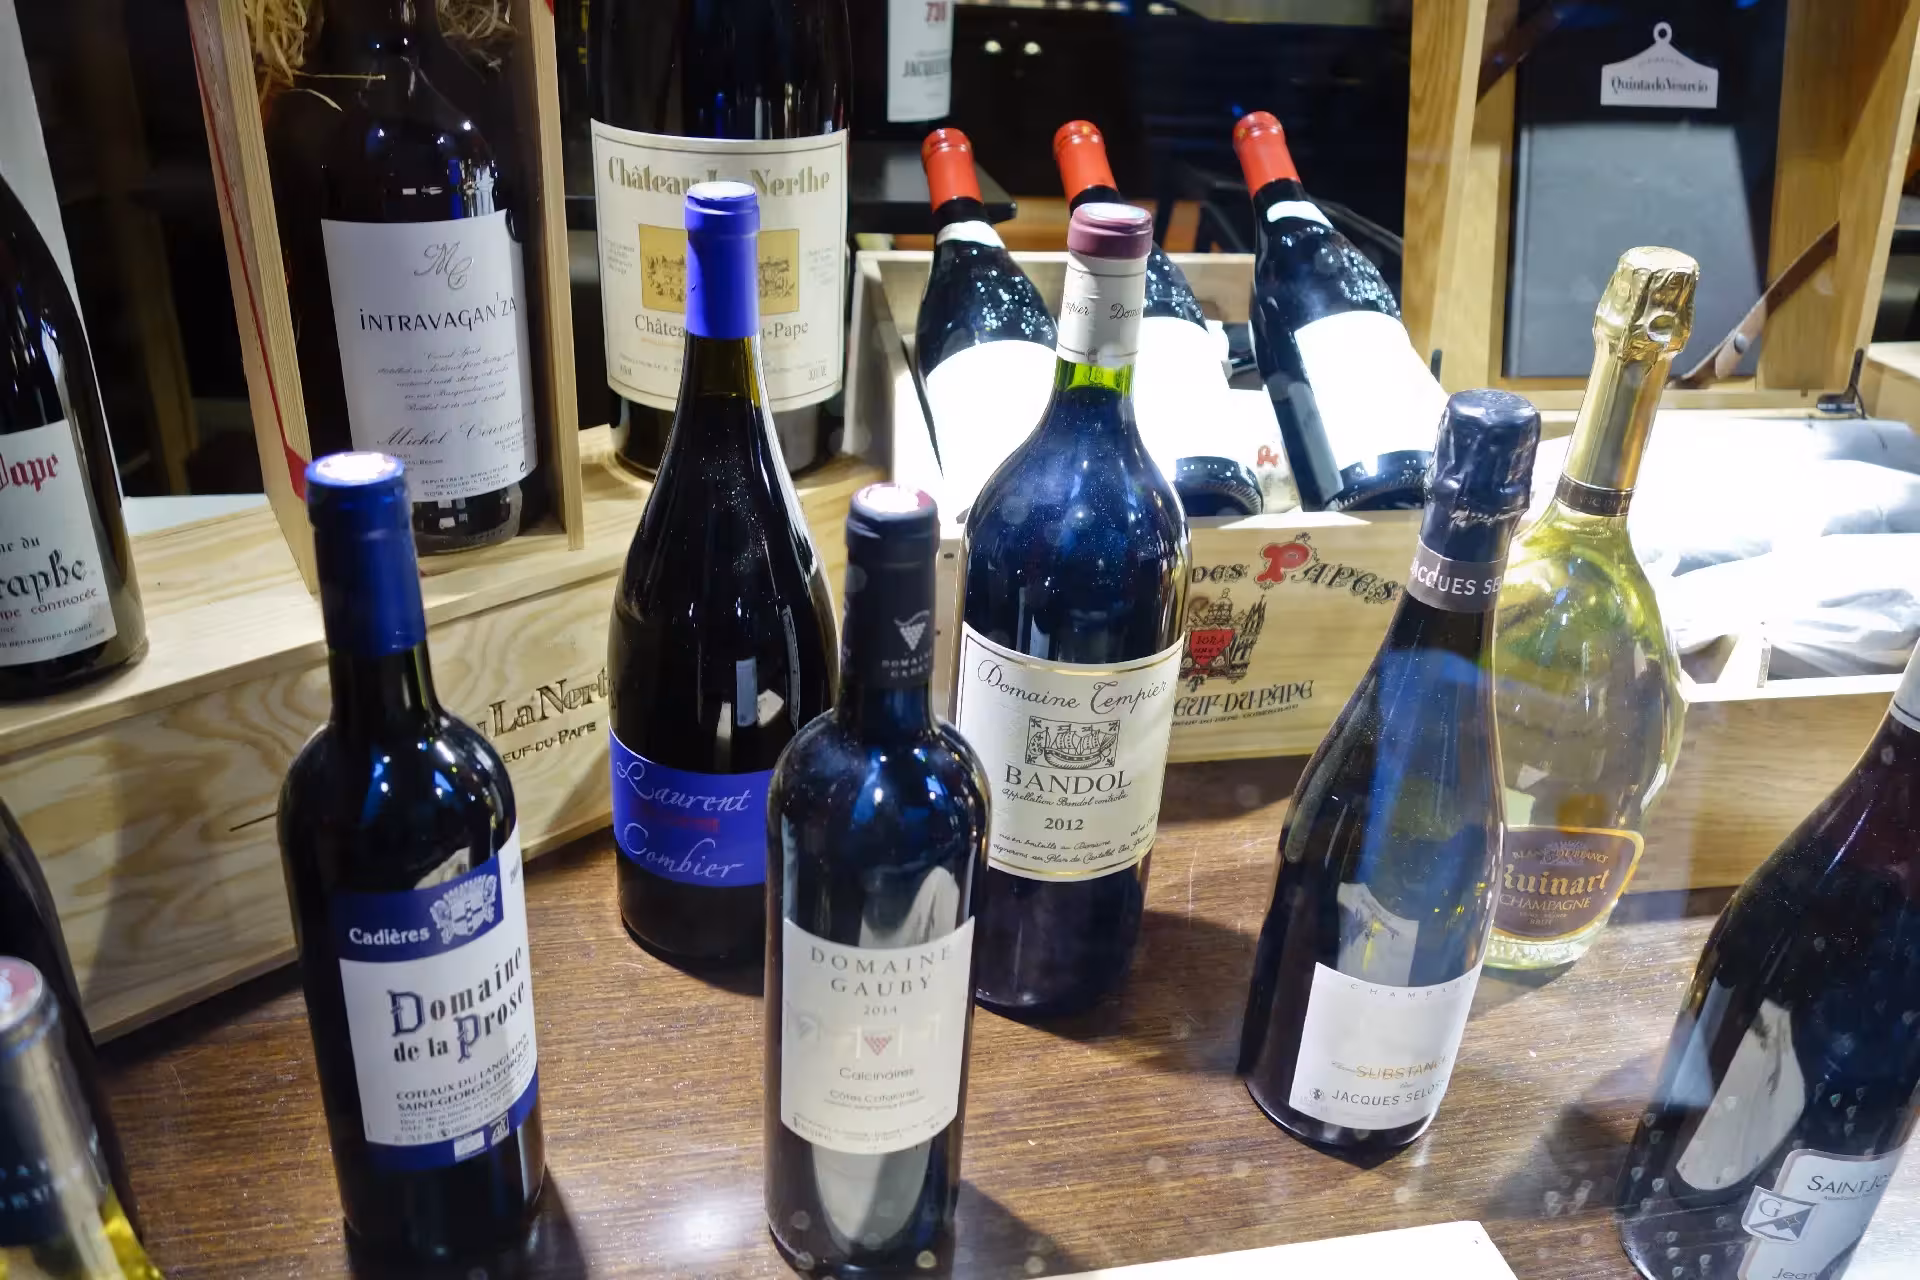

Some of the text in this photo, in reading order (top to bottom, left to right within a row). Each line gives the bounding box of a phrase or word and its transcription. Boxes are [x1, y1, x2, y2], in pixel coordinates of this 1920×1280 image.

[978, 659, 1081, 709] Domaine
[1090, 681, 1168, 715] Tempier
[616, 761, 752, 812] Laurent
[1005, 762, 1132, 795] BANDOL
[1044, 817, 1084, 831] 2012
[624, 823, 744, 878] Combier
[1499, 894, 1593, 911] CHAMPAGNE
[349, 926, 431, 946] Cadières
[811, 945, 951, 975] DOMAINE
[386, 946, 522, 1038] Domaine
[831, 974, 931, 997] GAUBY
[393, 980, 525, 1064] de la Prose
[1332, 1089, 1399, 1106] JACQUES
